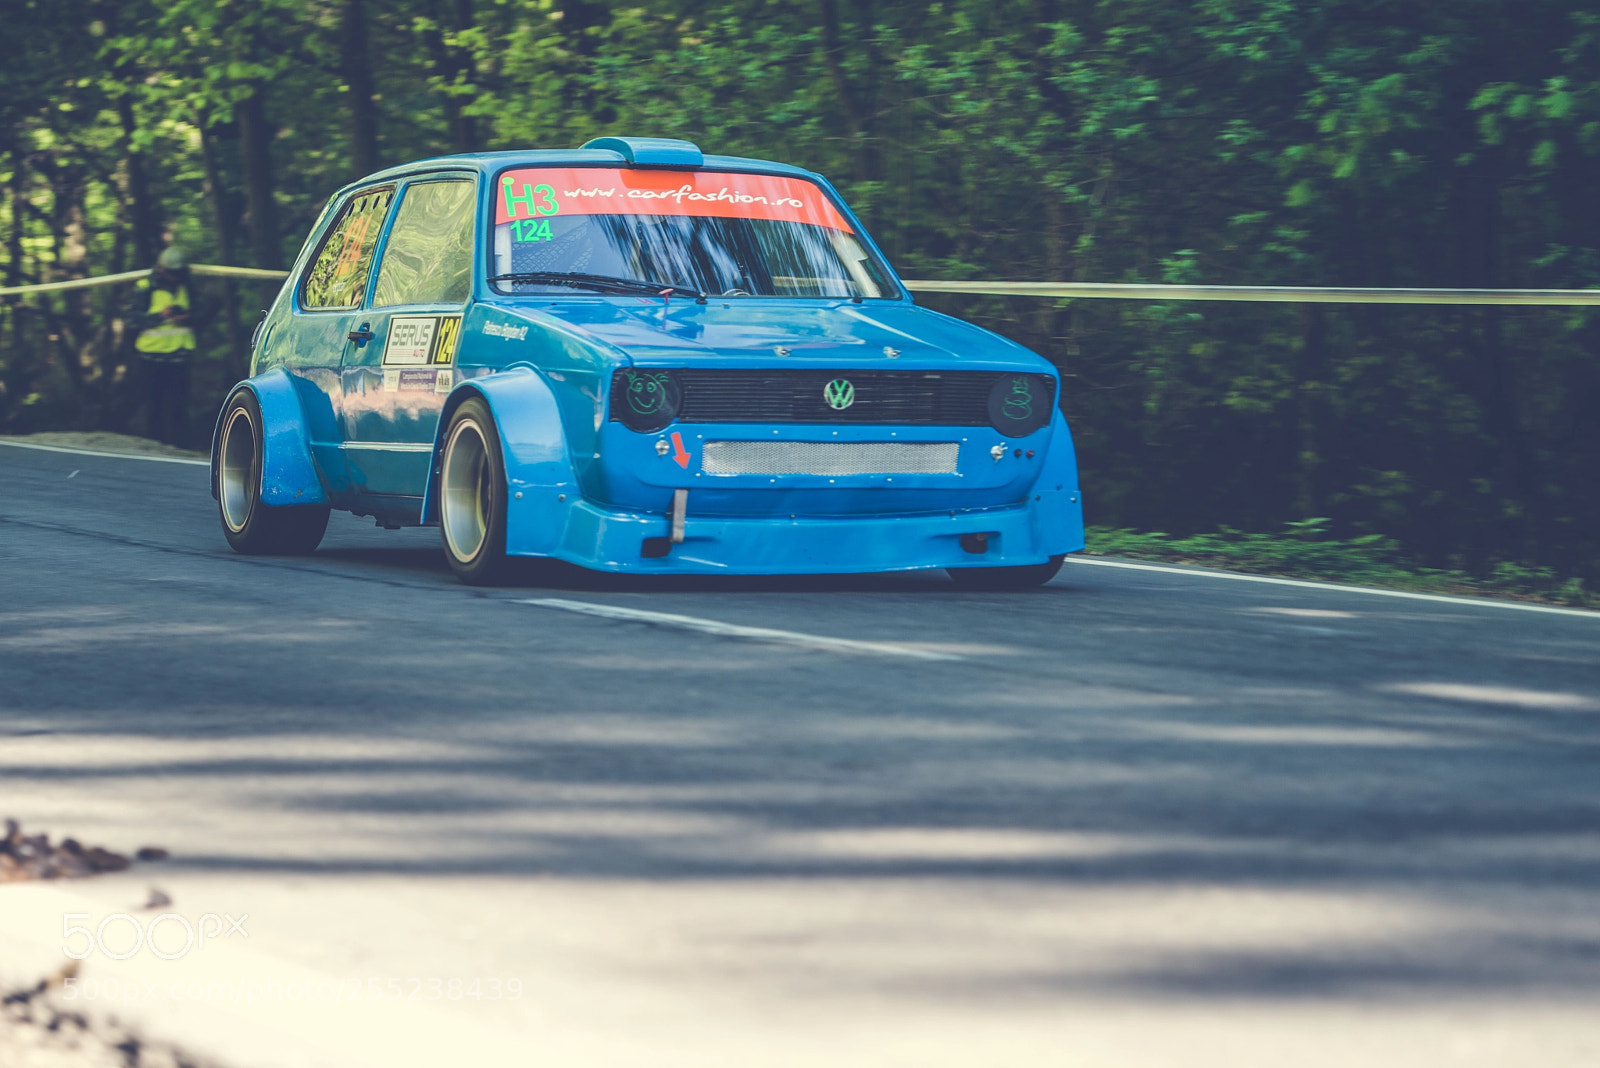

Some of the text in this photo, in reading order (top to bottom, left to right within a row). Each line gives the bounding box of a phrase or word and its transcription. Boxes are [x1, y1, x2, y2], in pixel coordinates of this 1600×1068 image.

[563, 184, 803, 208] www.carfashion.ro
[510, 219, 554, 242] 124
[391, 324, 431, 346] SERUS
[436, 318, 460, 362] 124
